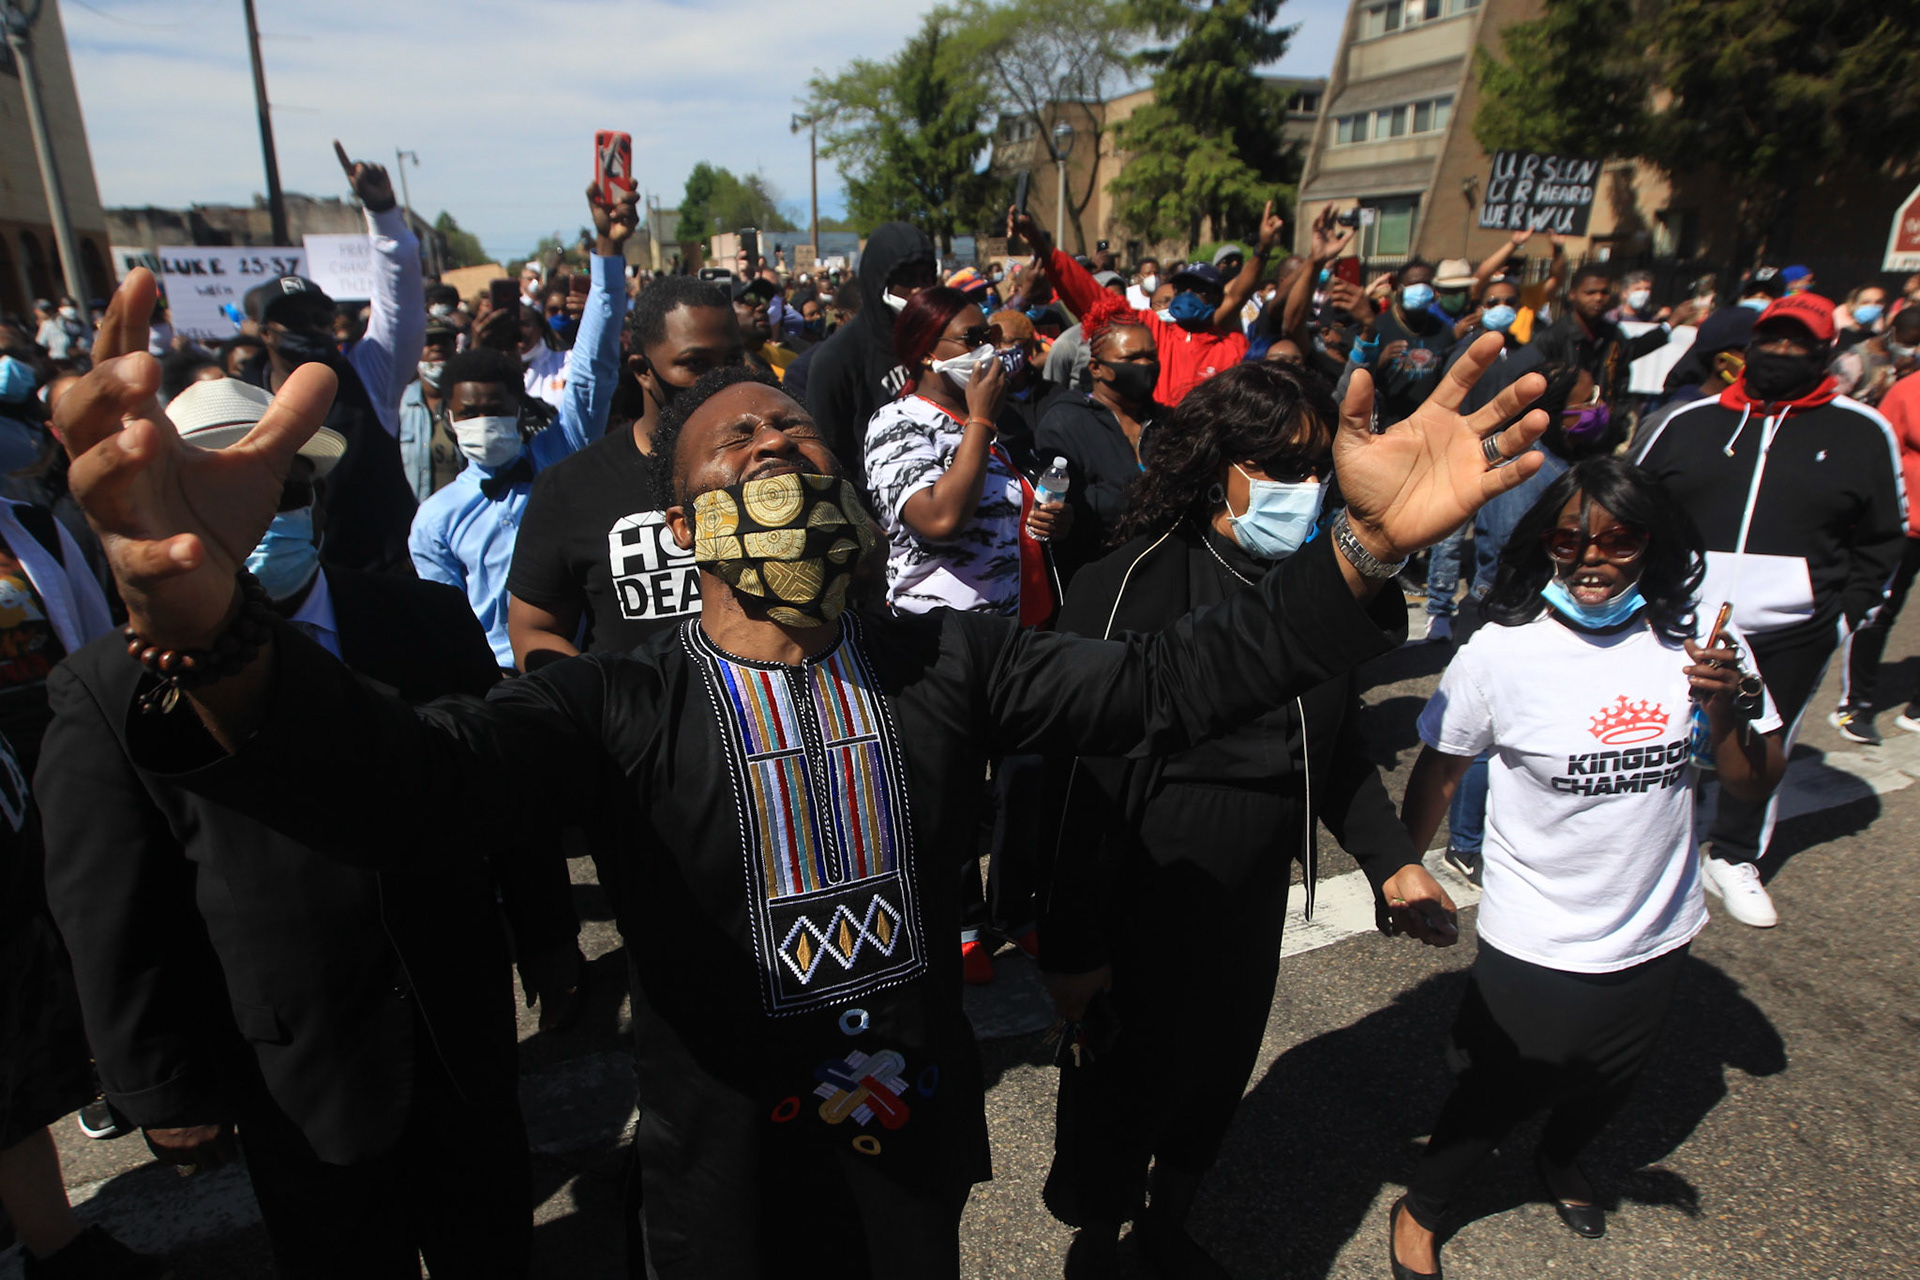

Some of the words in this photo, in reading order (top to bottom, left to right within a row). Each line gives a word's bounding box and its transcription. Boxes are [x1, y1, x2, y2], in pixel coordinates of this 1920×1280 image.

[1494, 152, 1517, 181] U
[1519, 154, 1540, 180] R
[1488, 180, 1508, 203] U
[1512, 180, 1533, 203] R
[1534, 184, 1593, 205] HEARD
[1480, 203, 1508, 226] WE
[1508, 204, 1525, 229] R
[1555, 207, 1575, 233] U
[162, 256, 226, 276] LUKE
[881, 365, 910, 396] CIT
